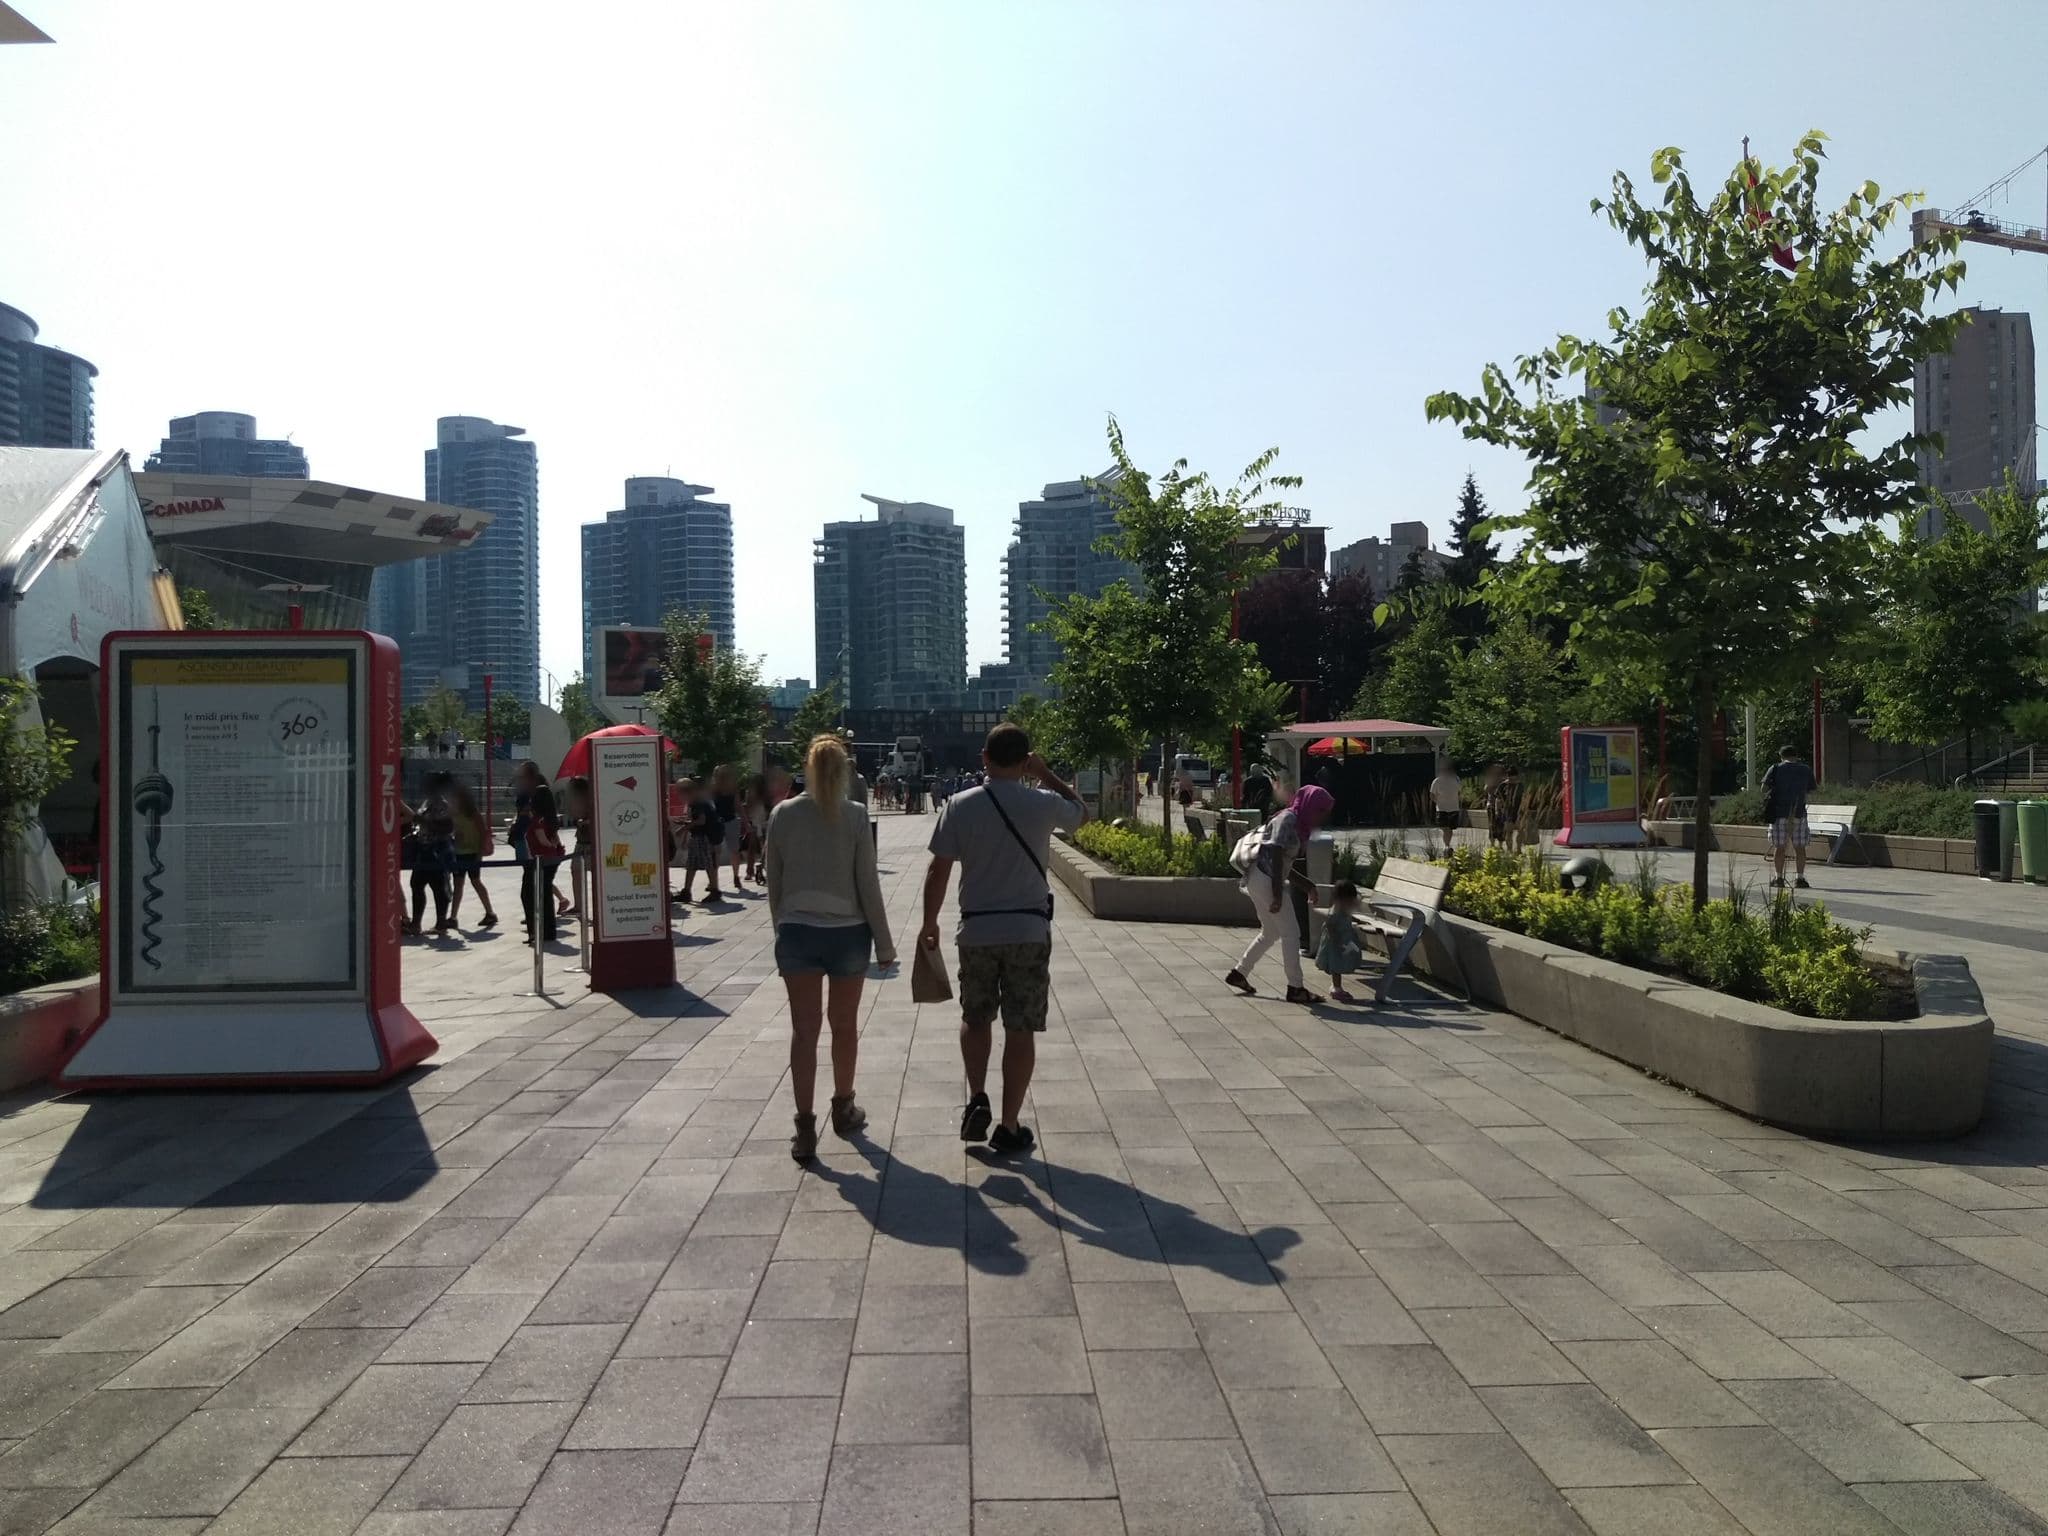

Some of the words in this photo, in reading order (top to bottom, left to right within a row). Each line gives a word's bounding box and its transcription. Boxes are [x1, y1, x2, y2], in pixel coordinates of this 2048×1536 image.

[153, 497, 225, 517] CANADA
[195, 712, 217, 720] midi
[220, 712, 239, 722] prix
[242, 712, 260, 720] fixe
[386, 671, 395, 752] TOWER
[281, 713, 318, 740] 360
[381, 764, 395, 834] CN
[617, 809, 640, 826] 360
[387, 842, 396, 904] TOUR
[607, 893, 633, 902] Special
[387, 914, 396, 944] LA
